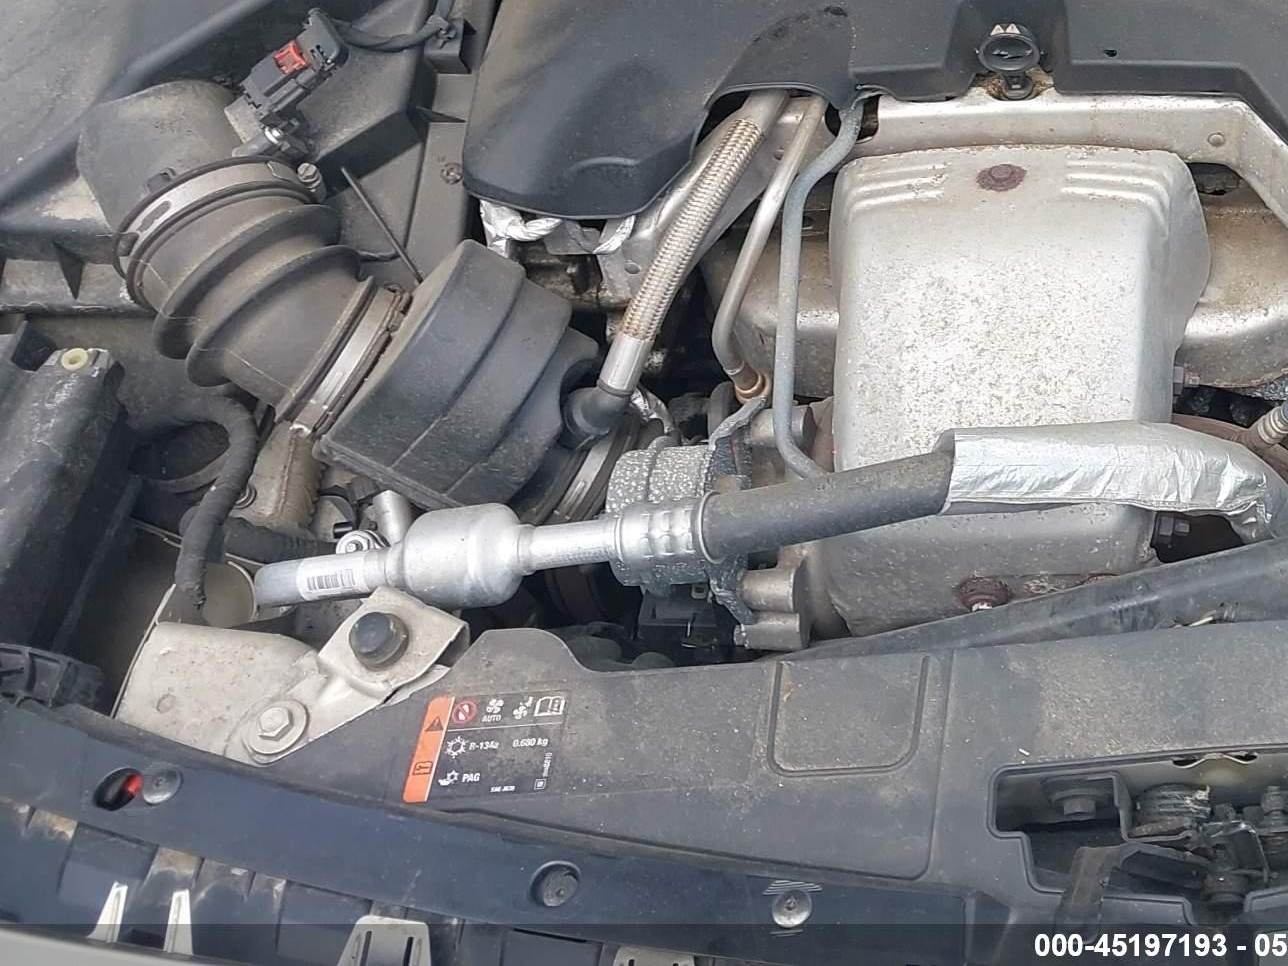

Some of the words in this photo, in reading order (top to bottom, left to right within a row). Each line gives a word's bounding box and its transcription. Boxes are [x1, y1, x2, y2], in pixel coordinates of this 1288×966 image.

[481, 714, 502, 723] AUTO
[536, 737, 549, 747] kg
[461, 772, 481, 783] PAG
